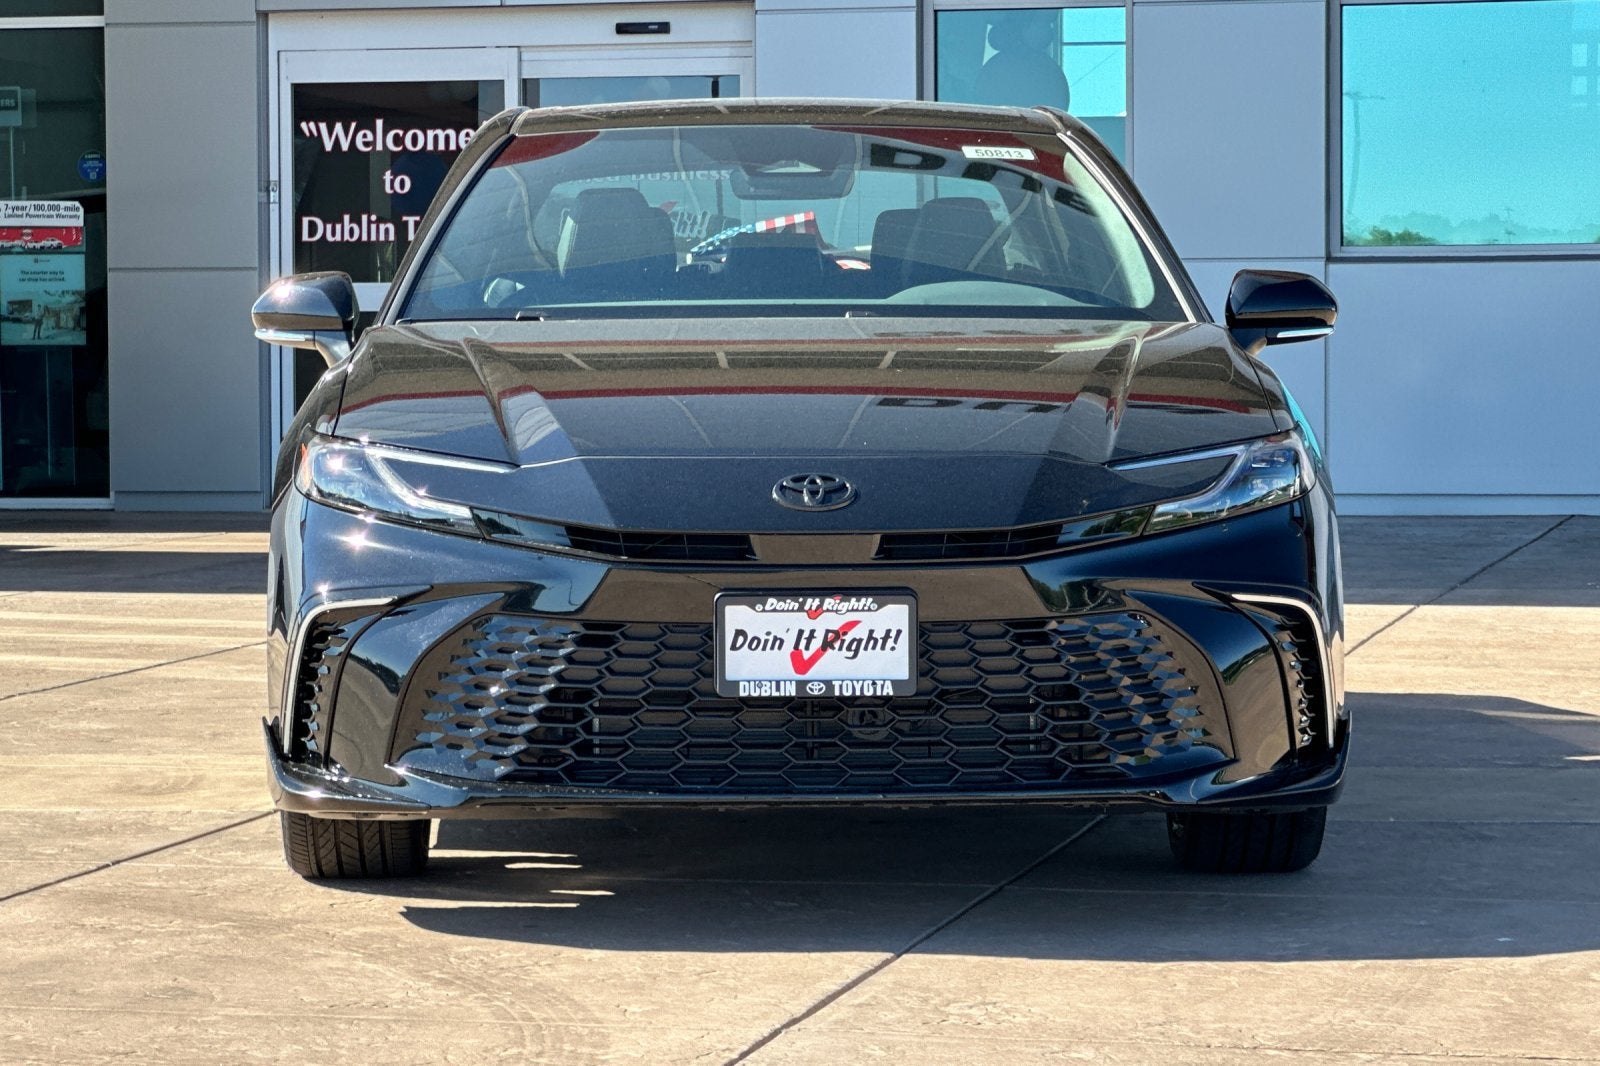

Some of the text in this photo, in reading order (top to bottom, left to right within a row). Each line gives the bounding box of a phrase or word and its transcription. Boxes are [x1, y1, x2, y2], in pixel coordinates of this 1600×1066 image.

[974, 148, 1025, 159] 50813
[383, 169, 411, 194] to
[301, 213, 395, 242] Dublin
[764, 597, 872, 614] Doin' It Right!
[729, 627, 903, 660] Doin' It Right!
[739, 680, 894, 697] DUBLIN TOYOTA
